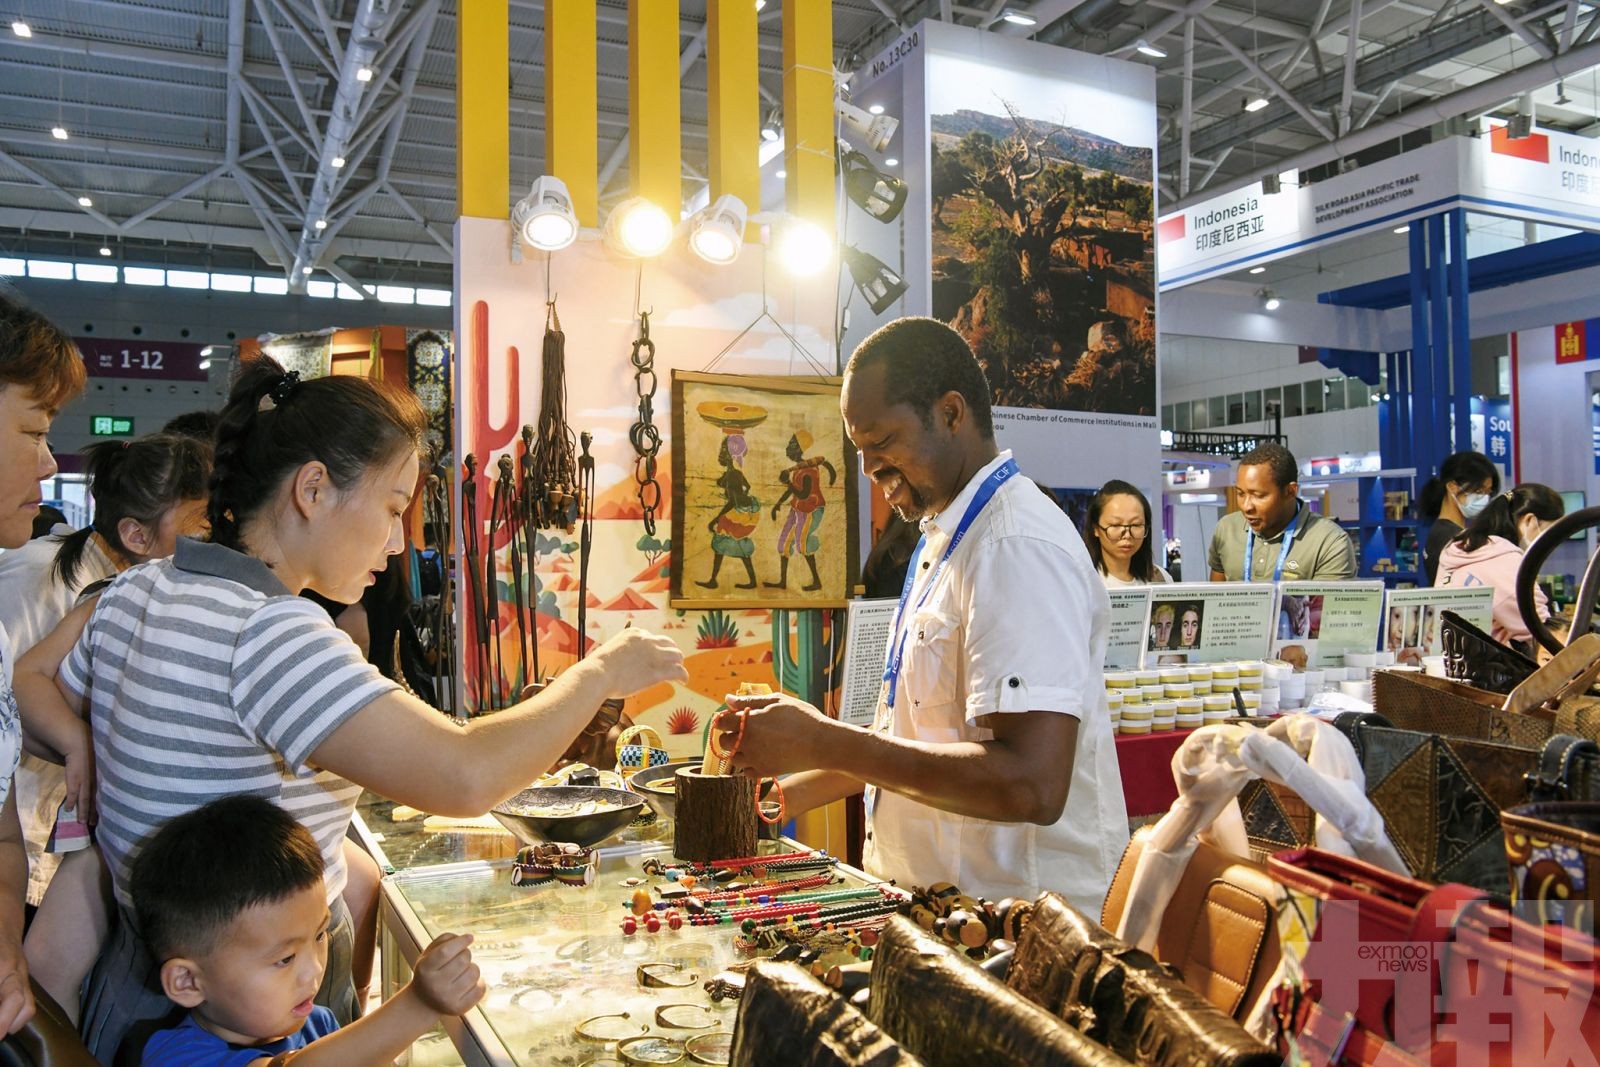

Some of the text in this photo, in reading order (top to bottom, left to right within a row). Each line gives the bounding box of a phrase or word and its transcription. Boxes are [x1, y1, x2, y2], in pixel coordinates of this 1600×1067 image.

[872, 32, 919, 78] No.13C30
[1559, 145, 1600, 170] Indon
[1315, 173, 1420, 214] SILK ROAD ASIA PACIFIC TRADE
[1315, 187, 1414, 224] DEVELOPMENT ASSOCIATION
[1194, 197, 1258, 230] Indonesia
[1195, 214, 1264, 252] 印度尼西亚
[121, 349, 164, 370] 1-12
[991, 411, 1015, 420] hinese
[1016, 413, 1048, 422] Chamber
[1050, 414, 1058, 423] of
[1058, 415, 1095, 425] Commerce
[1095, 417, 1134, 428] Institutions
[1135, 419, 1142, 428] in
[993, 466, 1010, 482] ICIF
